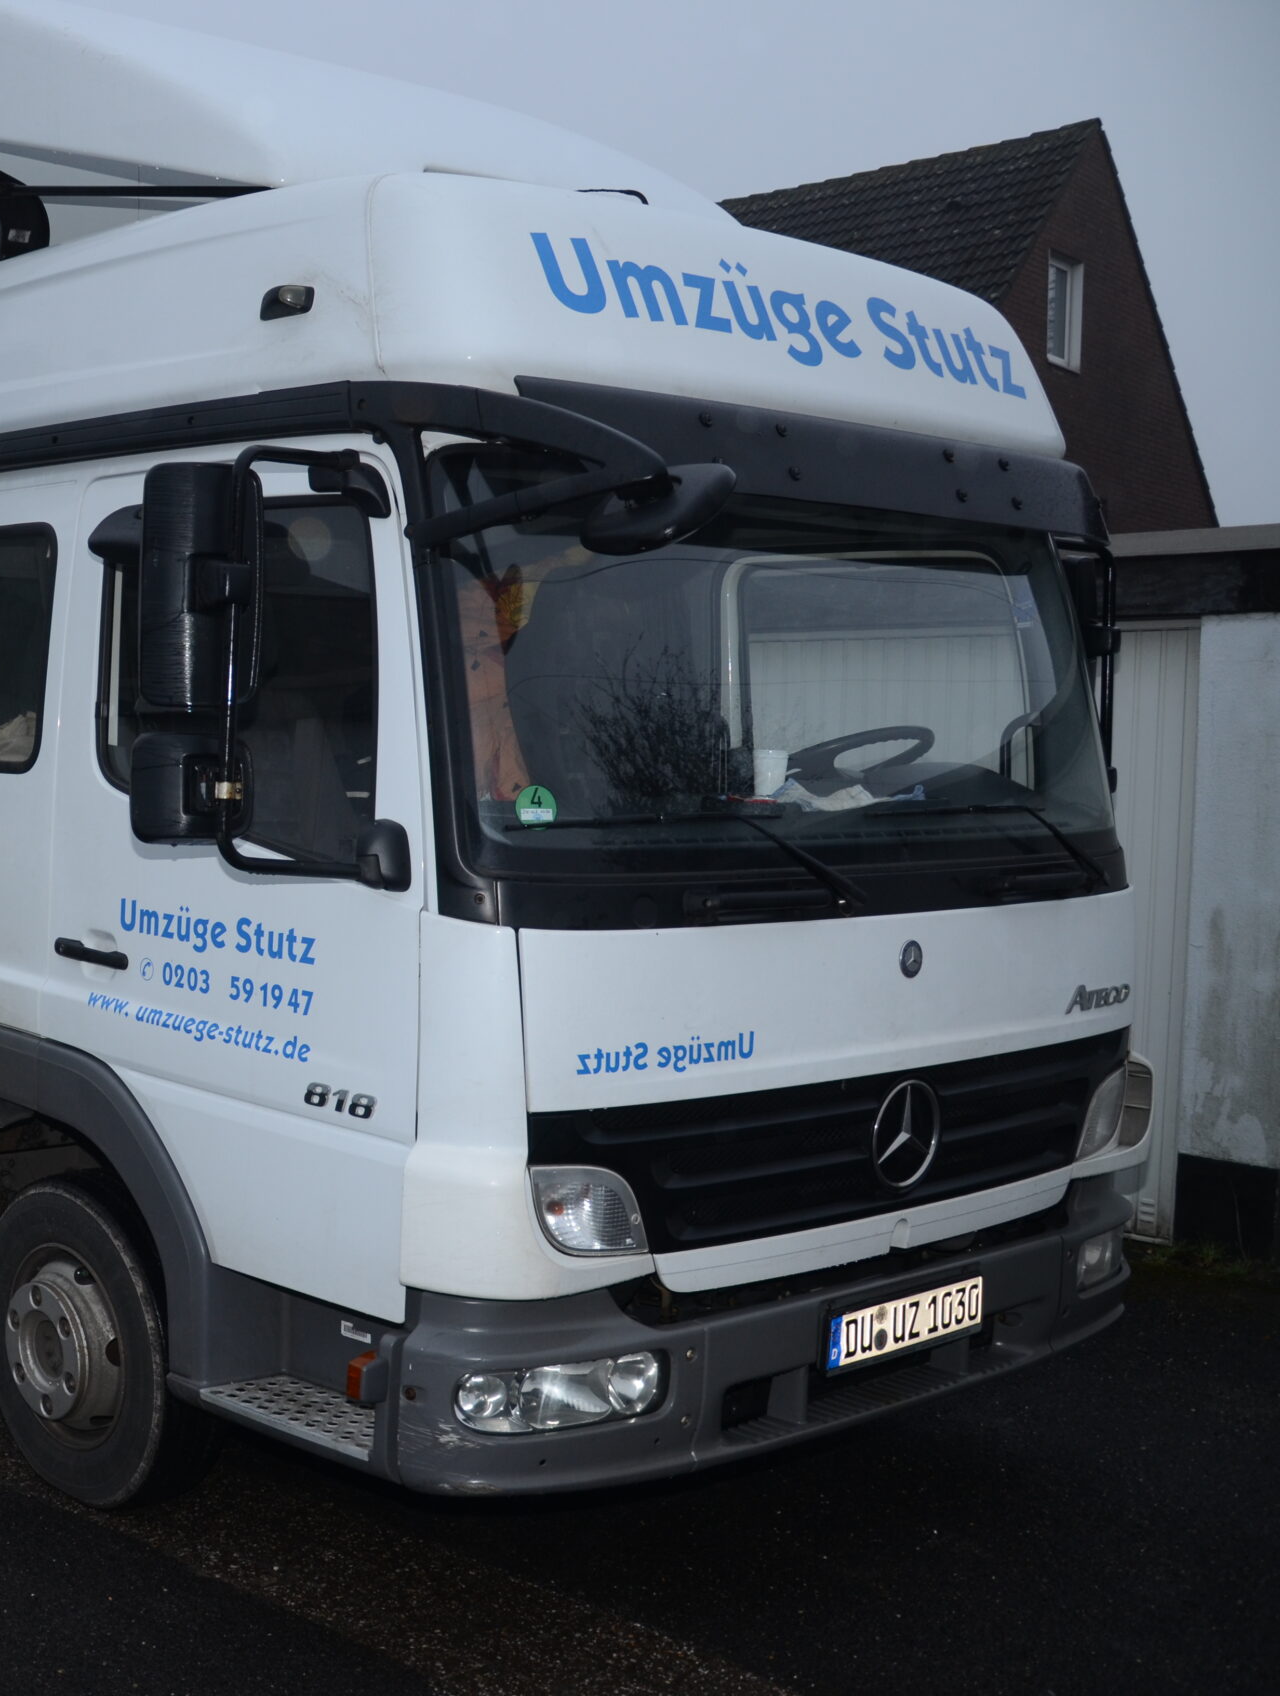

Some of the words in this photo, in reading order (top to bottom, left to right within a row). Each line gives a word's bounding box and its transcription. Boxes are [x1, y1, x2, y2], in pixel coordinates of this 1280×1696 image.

[529, 232, 863, 367] Umzüge
[866, 297, 1027, 400] Stutz
[531, 787, 542, 808] 4
[120, 898, 228, 954] Umzüge
[234, 916, 317, 965] Stutz
[162, 961, 211, 995] 0203
[304, 1082, 378, 1119] 818
[844, 1313, 874, 1359] DU
[892, 1300, 920, 1345] UZ
[926, 1283, 979, 1335] 1030
[831, 1348, 838, 1360] D
